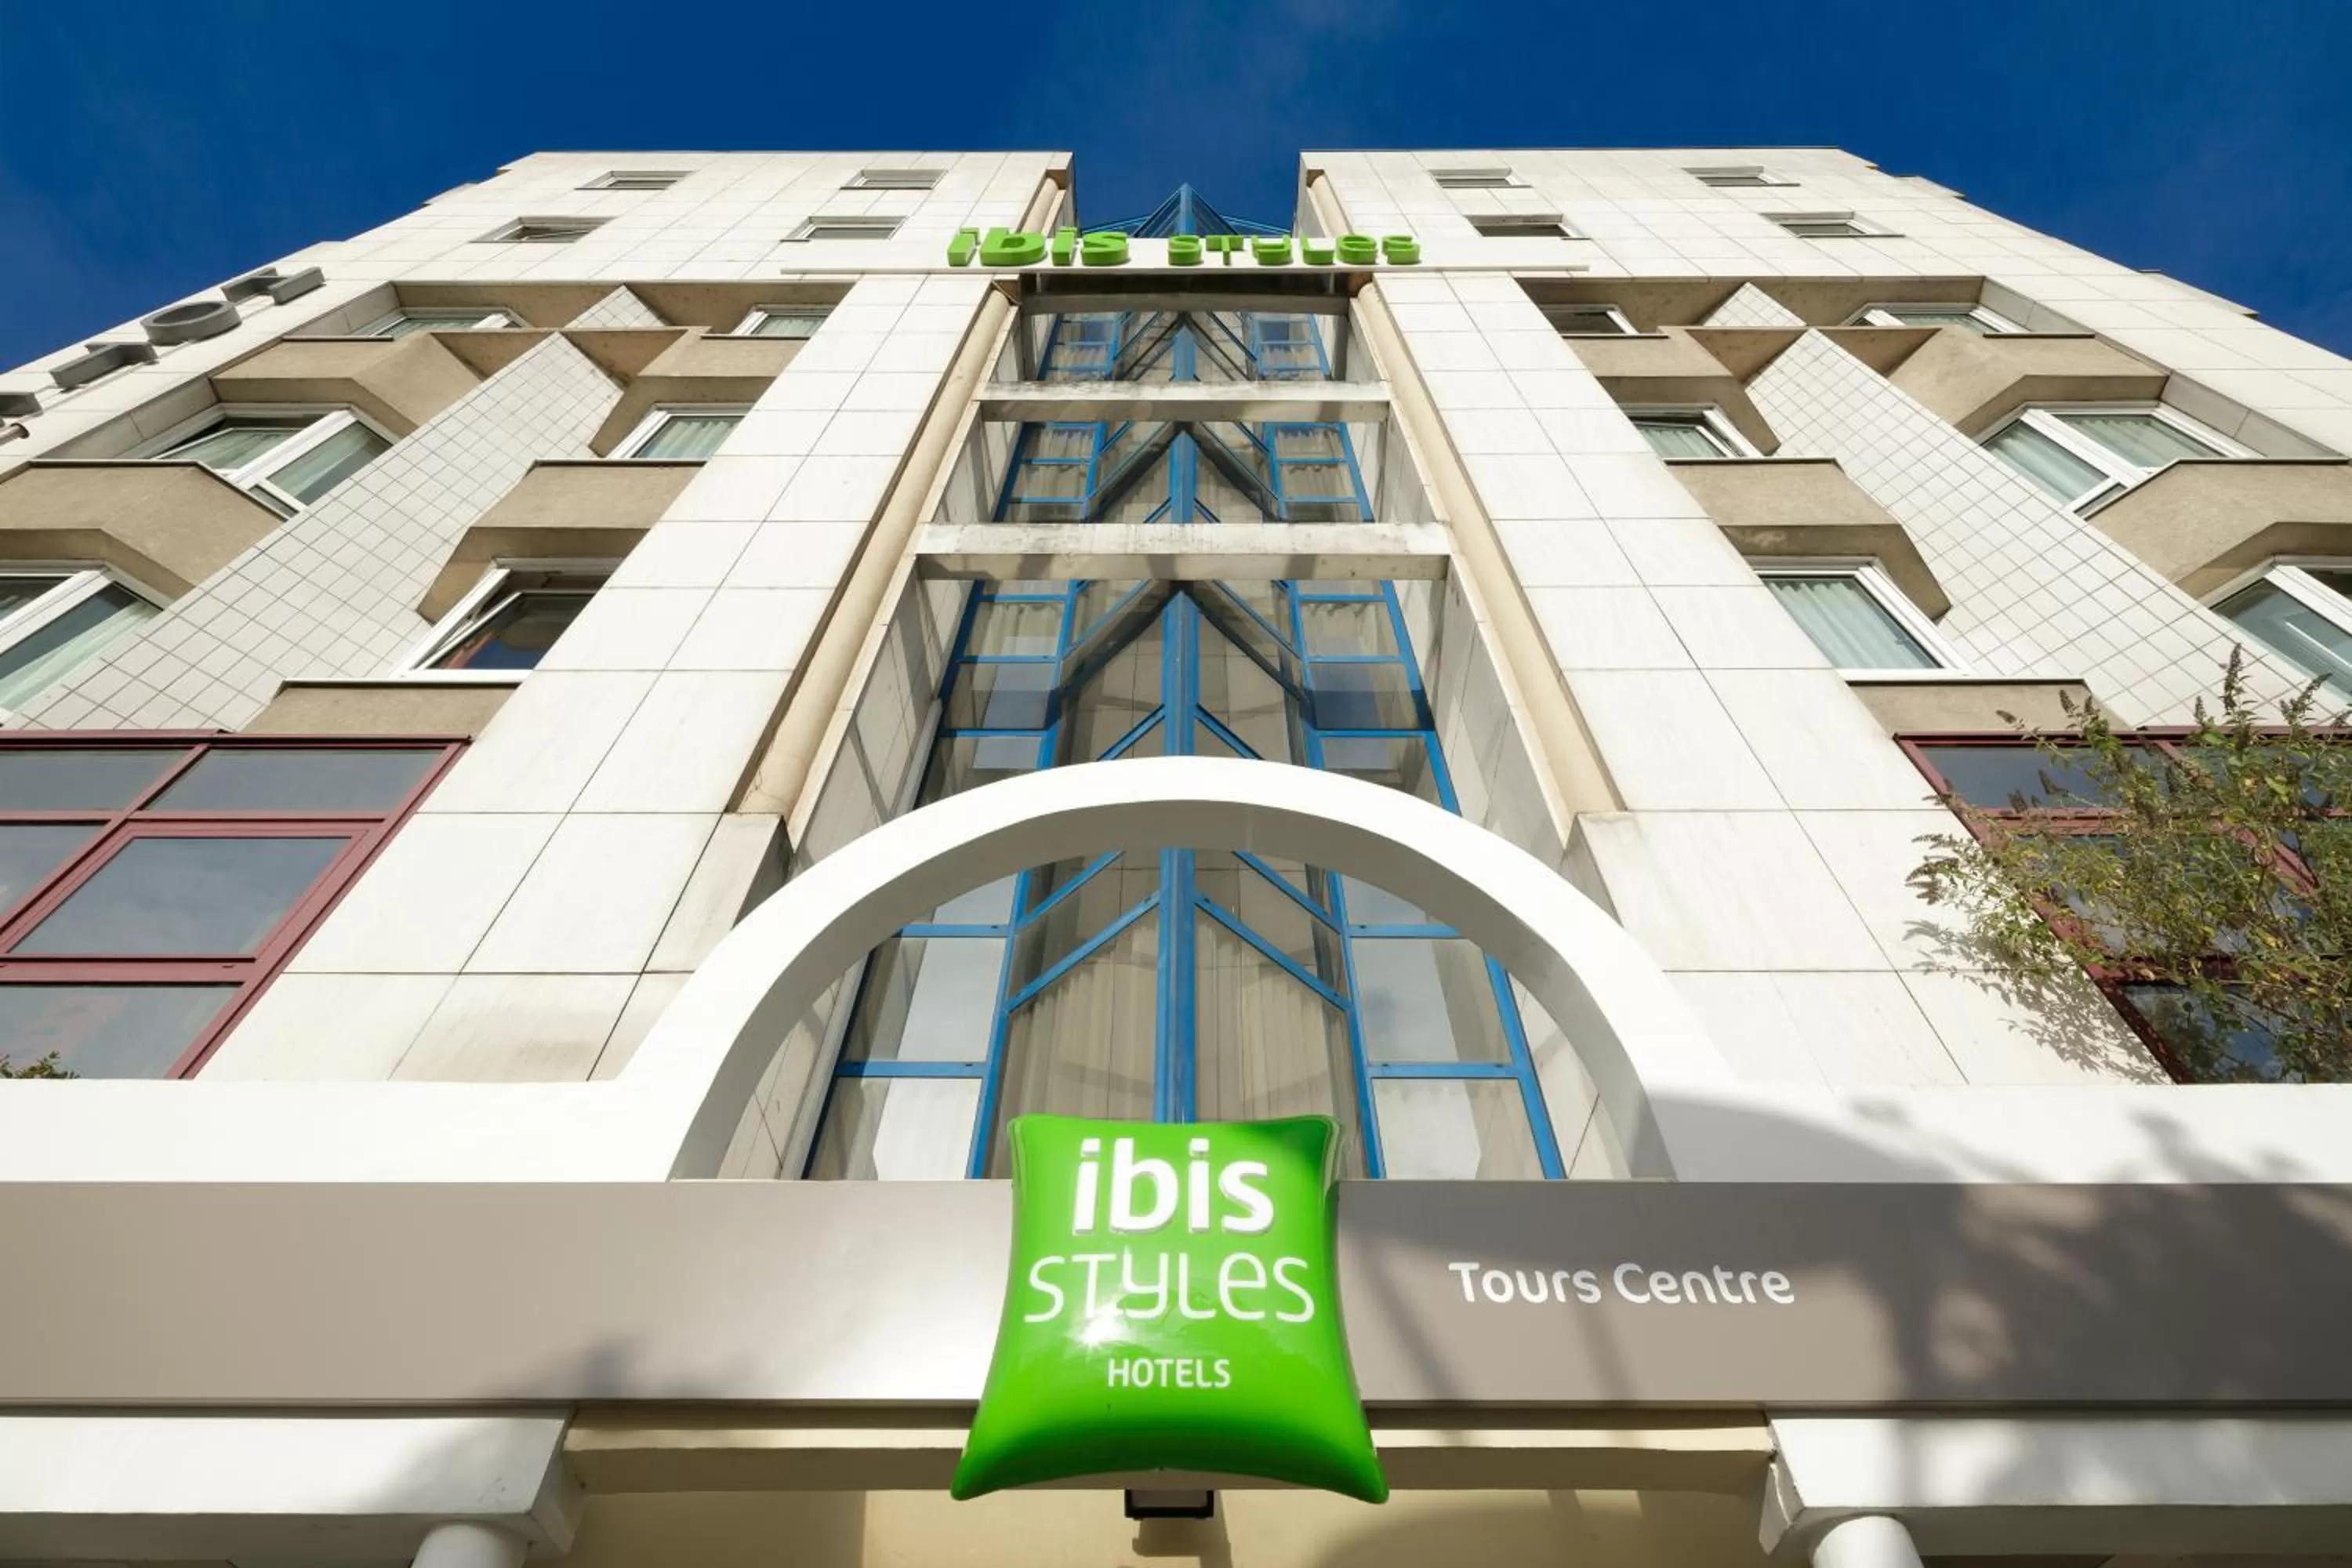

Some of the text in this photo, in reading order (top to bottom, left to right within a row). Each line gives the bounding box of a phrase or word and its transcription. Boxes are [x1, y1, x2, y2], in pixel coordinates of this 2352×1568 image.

[948, 227, 1128, 267] ibis
[1073, 1138, 1275, 1235] ibis
[1448, 1261, 1795, 1305] Tours Centre
[1108, 1359, 1232, 1388] HOTELS
